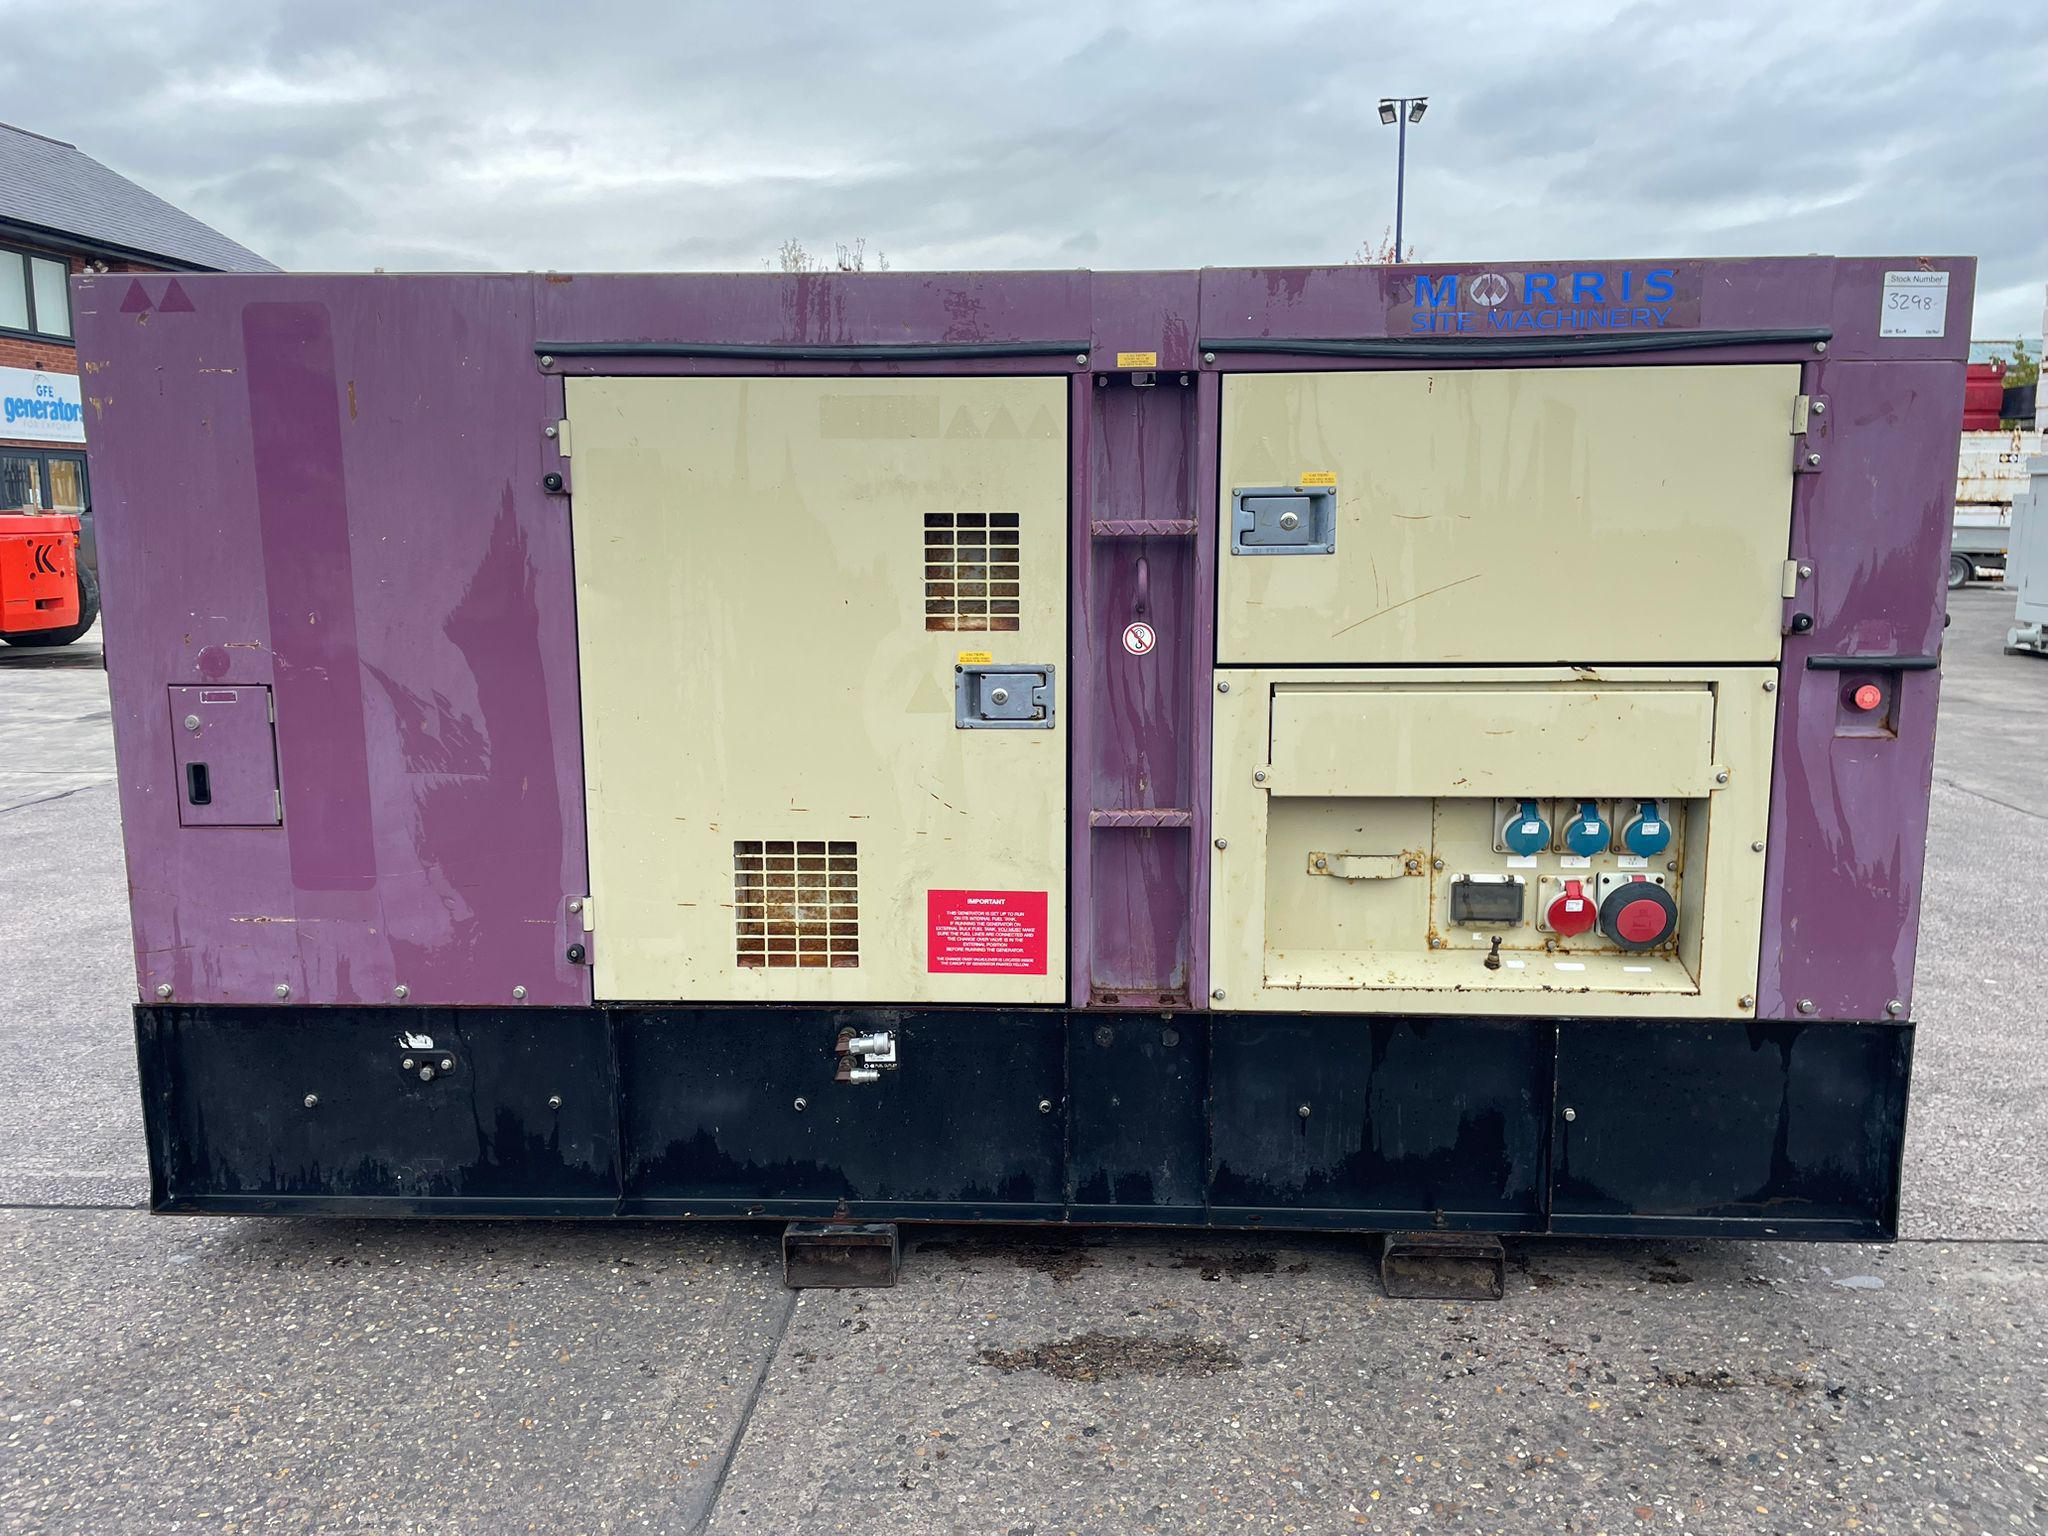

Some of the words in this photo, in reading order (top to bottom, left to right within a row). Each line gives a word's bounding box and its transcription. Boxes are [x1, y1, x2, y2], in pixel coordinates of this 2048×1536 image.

[1890, 274, 1911, 283] Stock
[1913, 275, 1943, 283] Number
[1414, 269, 1676, 307] MORRIS
[1887, 292, 1933, 310] 3298
[1411, 311, 1476, 334] SITE
[1487, 306, 1673, 330] MACHINERY
[36, 385, 54, 398] GFE
